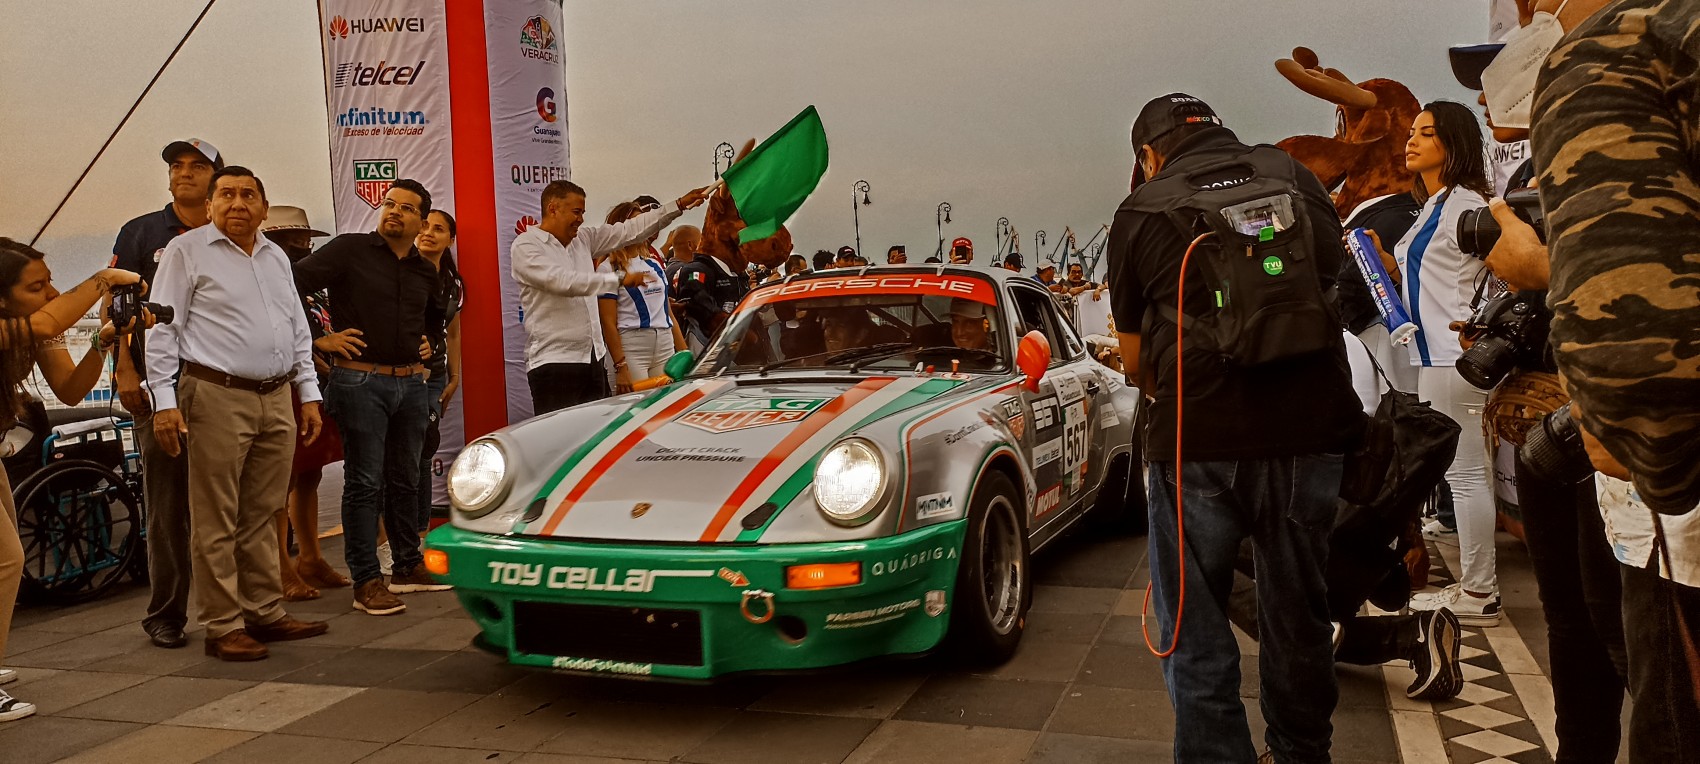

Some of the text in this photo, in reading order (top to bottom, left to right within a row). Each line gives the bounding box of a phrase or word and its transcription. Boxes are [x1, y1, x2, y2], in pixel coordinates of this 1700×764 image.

[351, 17, 424, 34] HUAWEI
[520, 47, 559, 64] VERACRUZ
[351, 61, 426, 87] telcel
[347, 126, 425, 137] Exceso de Velocidad
[356, 163, 393, 178] TAG
[1264, 260, 1282, 269] TVU
[751, 278, 975, 304] PORSCHE
[713, 399, 817, 410] TAG
[1003, 401, 1022, 417] TAG
[684, 411, 803, 429] HEUER
[1066, 420, 1087, 468] 567
[635, 454, 746, 463] UNDER PRESSURE
[1035, 485, 1060, 517] MOTUL
[488, 561, 543, 586] TOY
